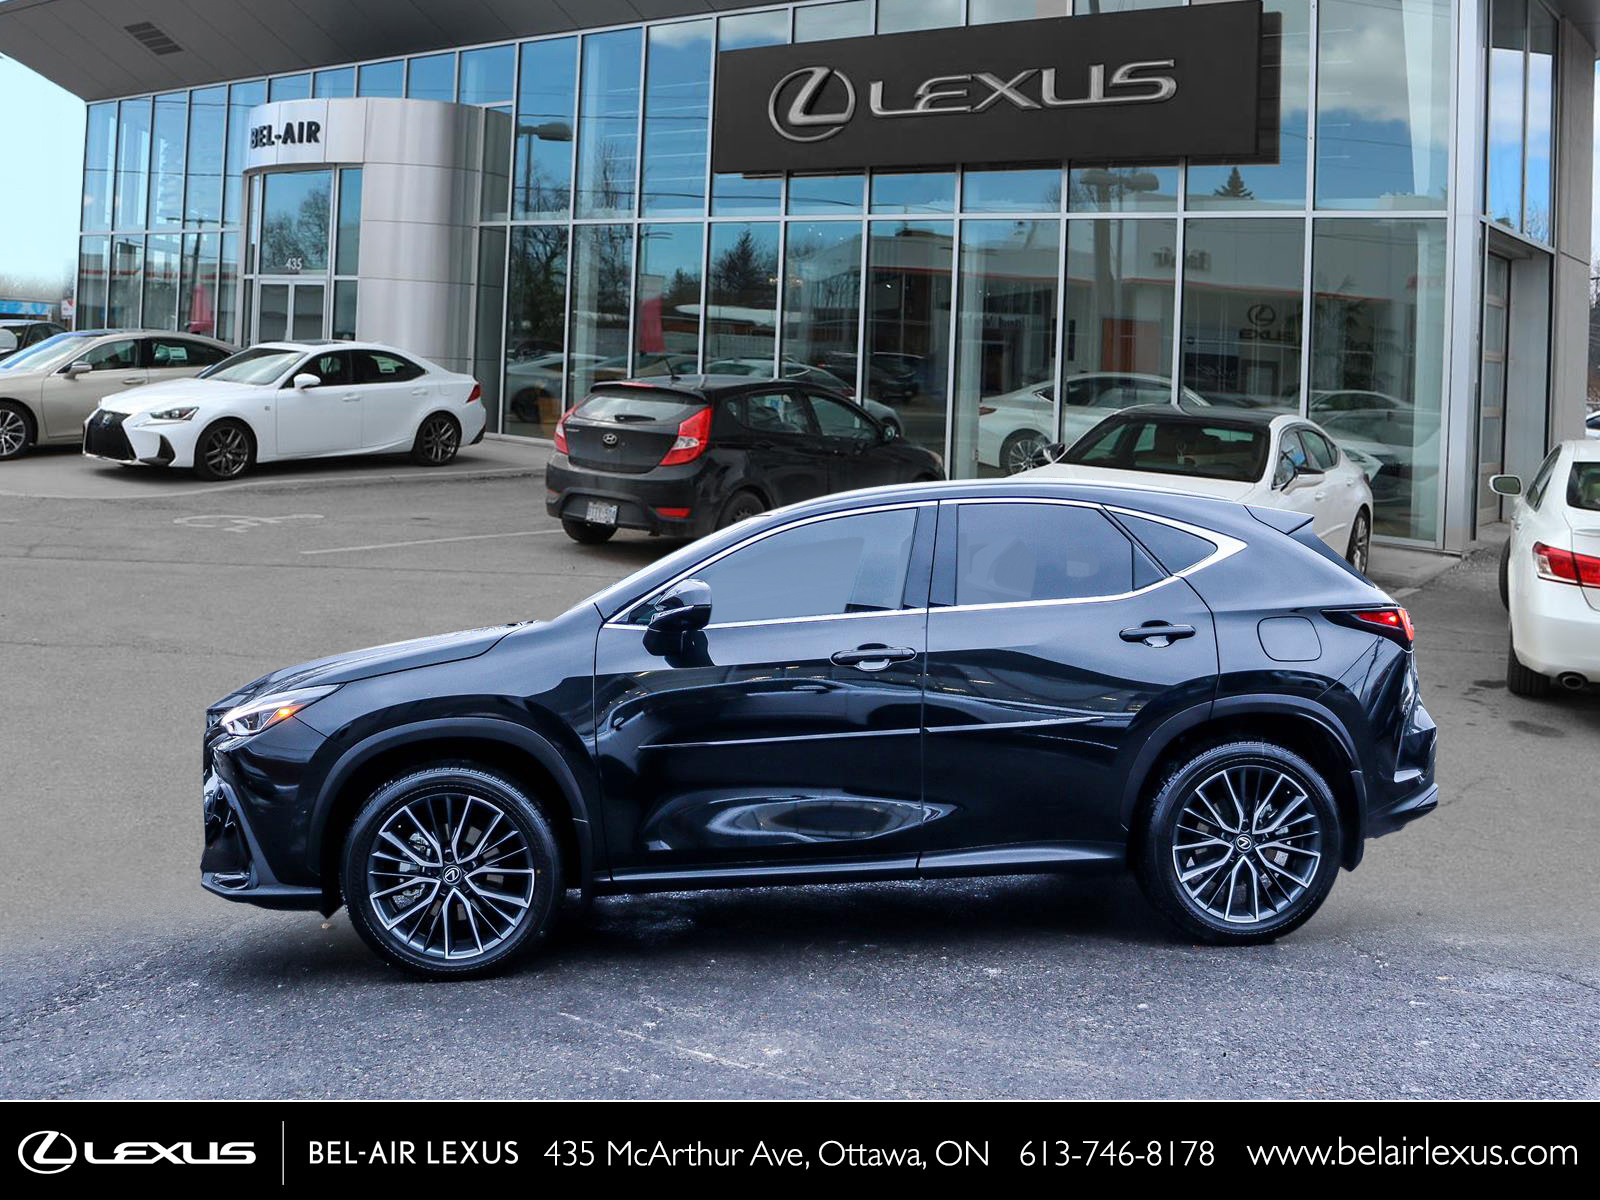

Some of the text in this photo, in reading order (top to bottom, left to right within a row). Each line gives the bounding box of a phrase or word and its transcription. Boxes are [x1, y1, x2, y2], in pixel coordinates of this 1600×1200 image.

[869, 58, 1178, 118] LEXUS
[250, 121, 321, 149] BEL-AIR
[285, 257, 303, 270] 435
